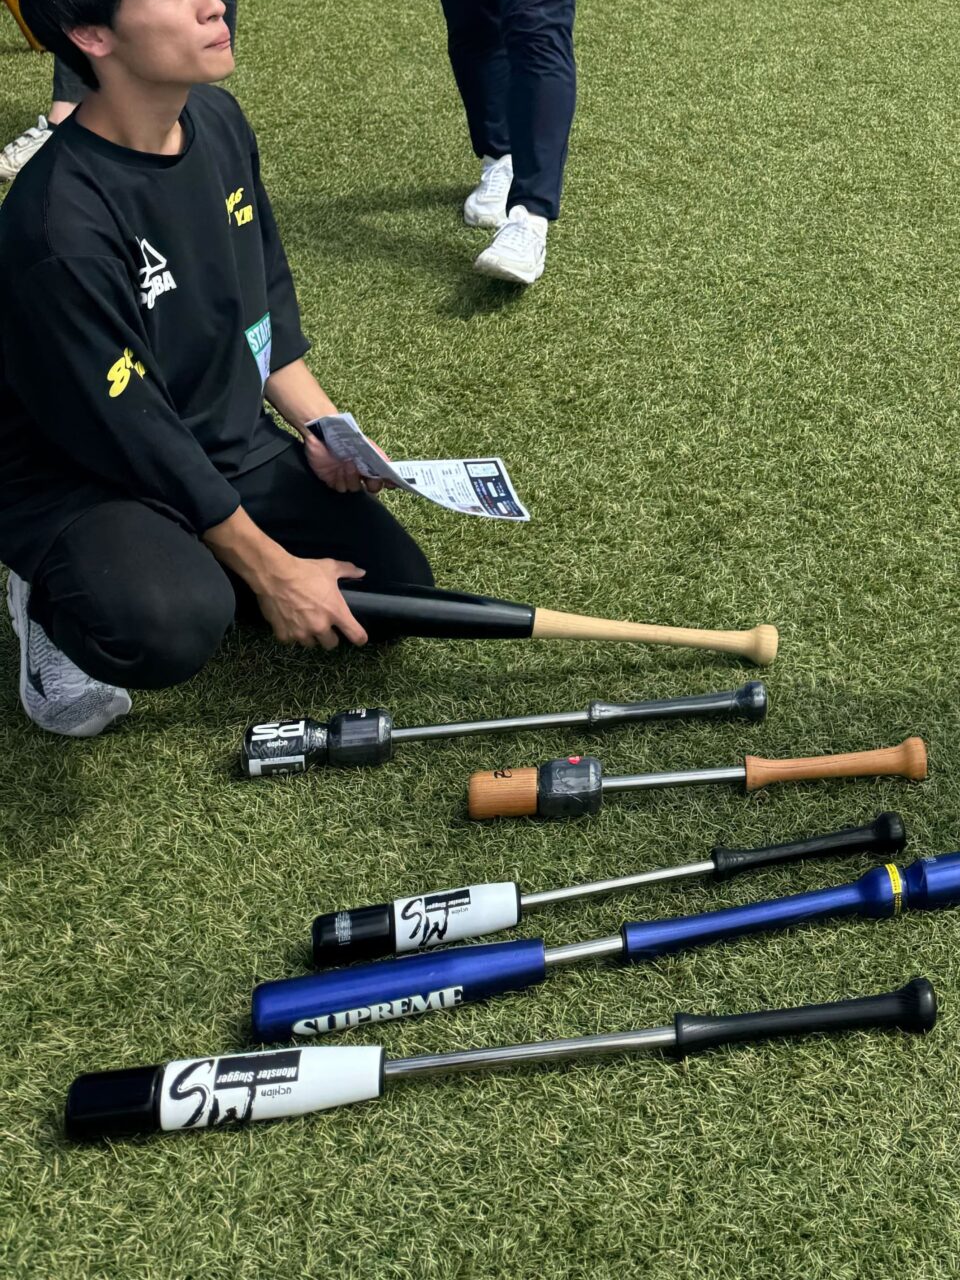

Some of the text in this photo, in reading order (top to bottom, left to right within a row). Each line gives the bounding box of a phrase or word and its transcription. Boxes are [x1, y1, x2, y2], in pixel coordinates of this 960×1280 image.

[252, 720, 305, 742] PS
[291, 985, 464, 1036] SUPREME
[216, 1066, 298, 1084] Monster Slugger
